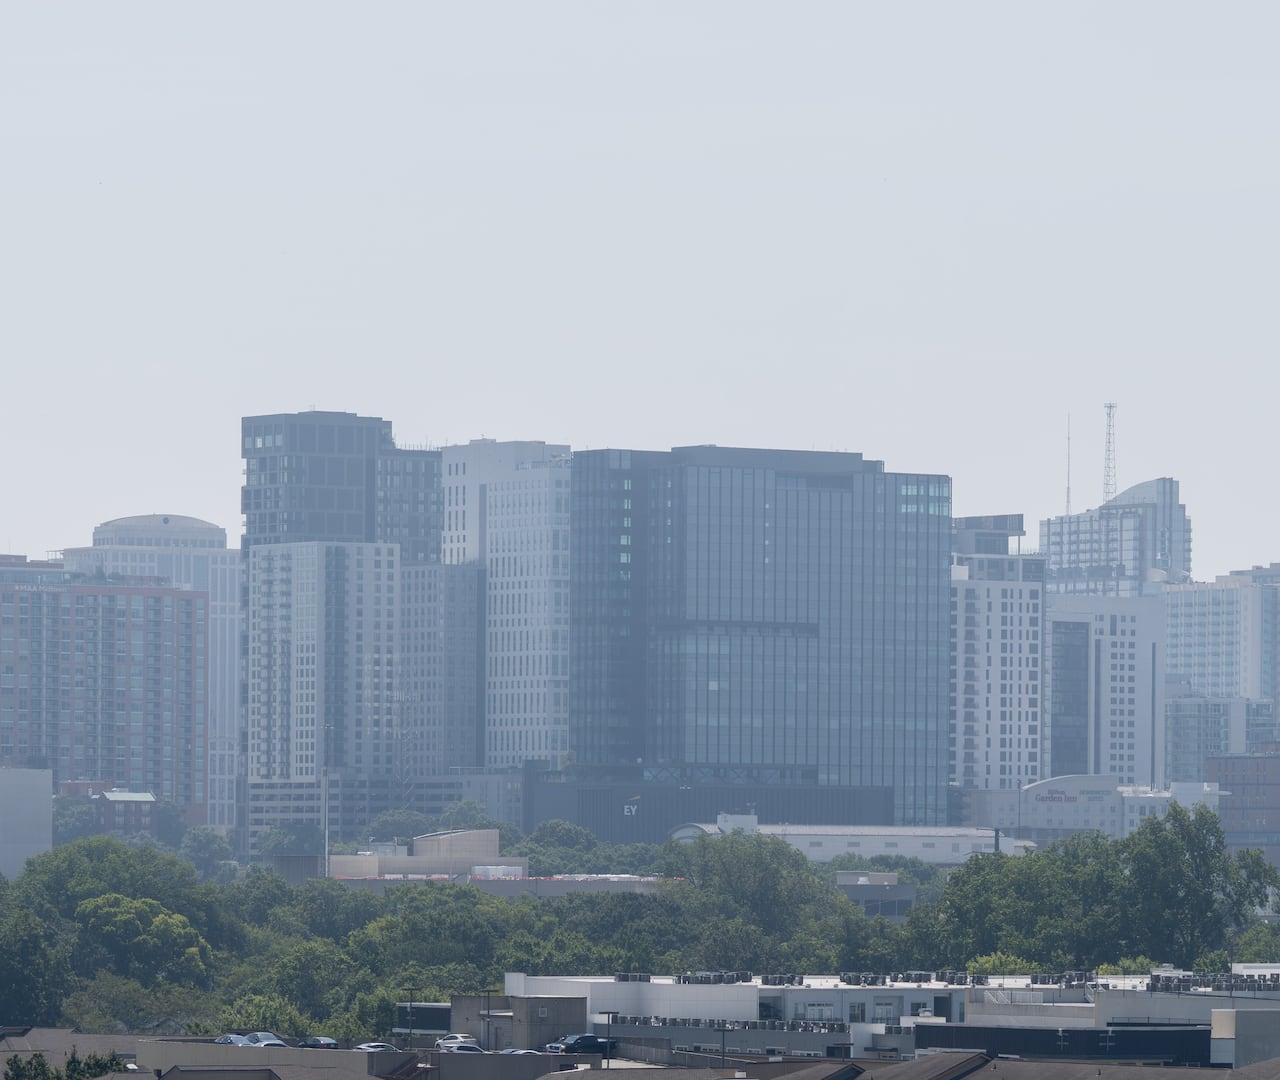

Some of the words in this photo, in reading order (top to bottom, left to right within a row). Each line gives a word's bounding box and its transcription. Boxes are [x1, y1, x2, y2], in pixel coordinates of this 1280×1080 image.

[1035, 794, 1063, 802] Garden
[1064, 794, 1077, 802] Inn
[624, 805, 637, 816] EY
